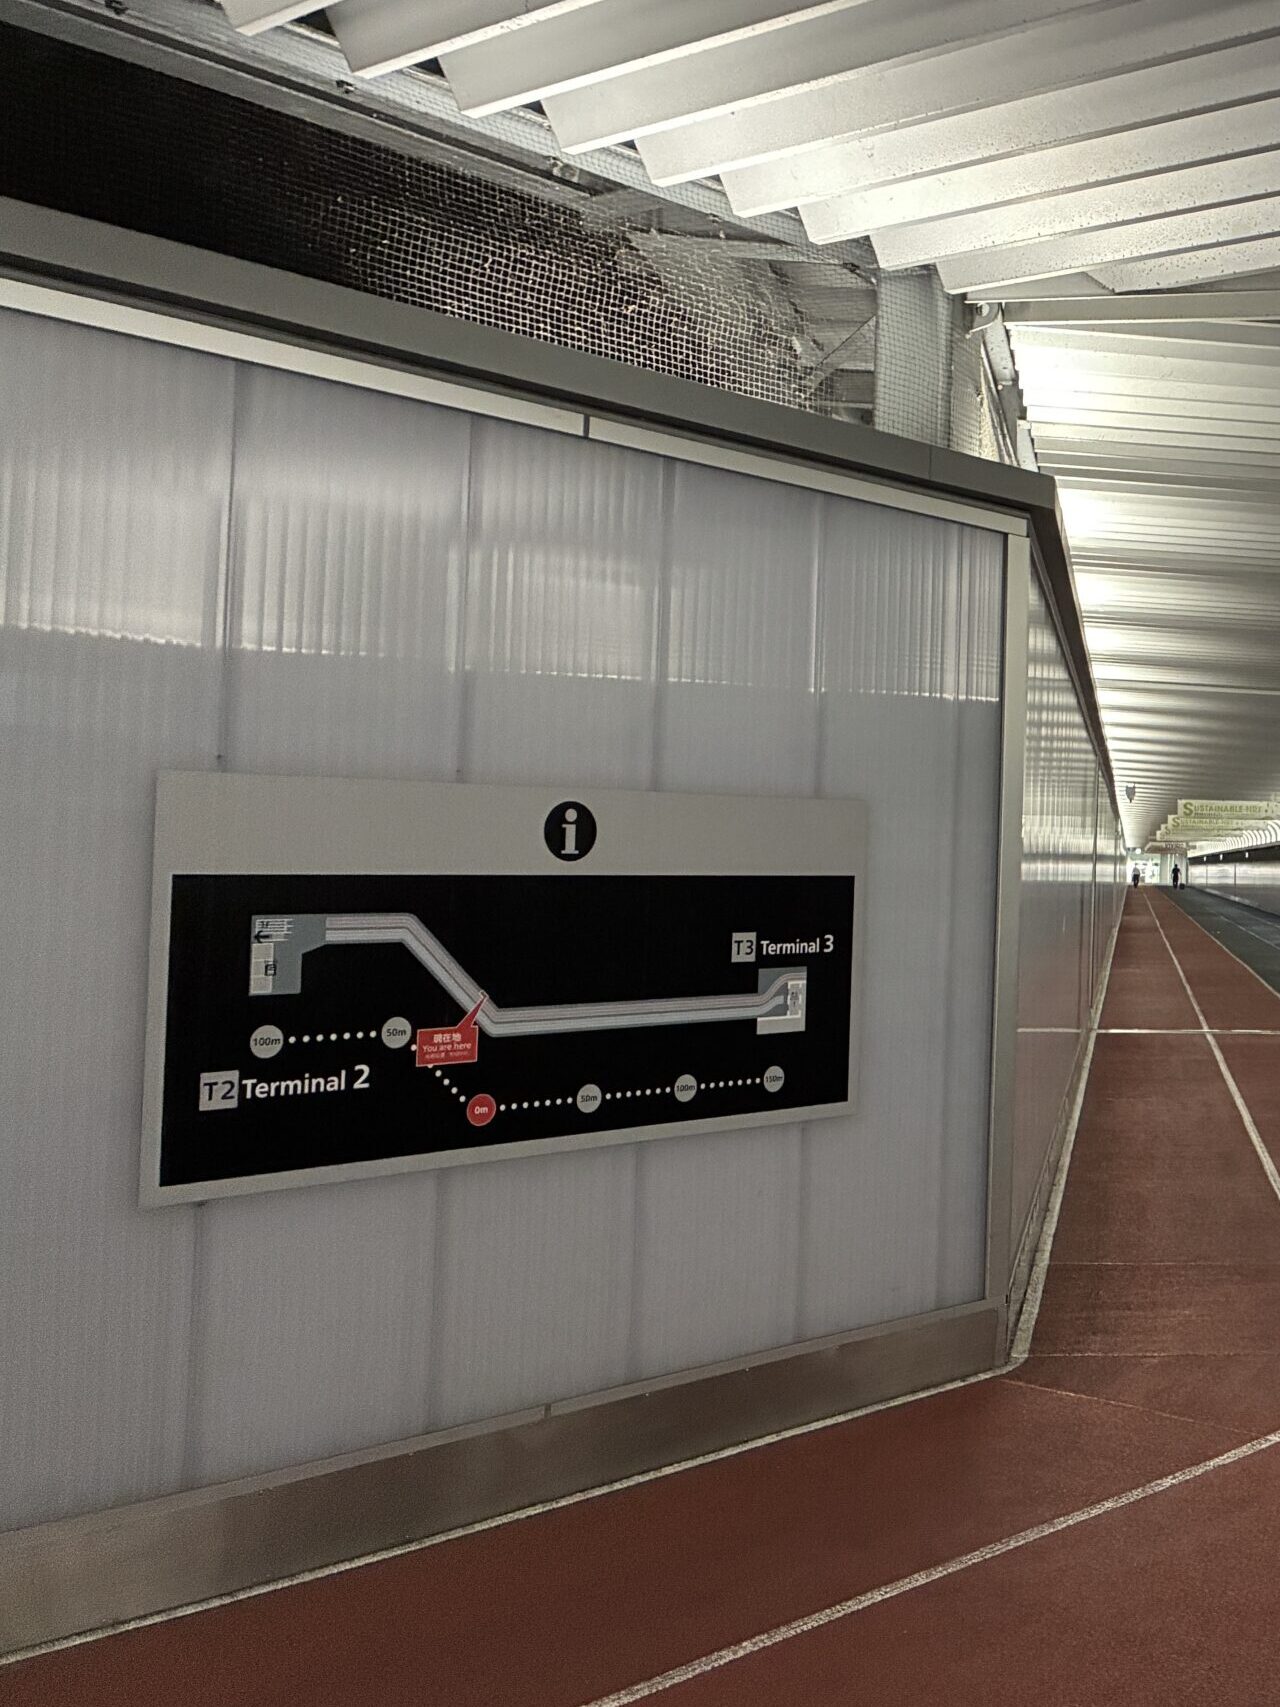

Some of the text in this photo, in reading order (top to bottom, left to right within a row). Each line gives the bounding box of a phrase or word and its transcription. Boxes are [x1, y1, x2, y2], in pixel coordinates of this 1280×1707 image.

[734, 934, 834, 955] T3 Terminal 3
[386, 1027, 407, 1037] 50m
[253, 1036, 281, 1046] 100m
[423, 1045, 438, 1053] You
[454, 1042, 472, 1050] here
[203, 1064, 370, 1101] T2 Terminal 2
[580, 1093, 598, 1103] 50m
[474, 1105, 489, 1115] 0m
